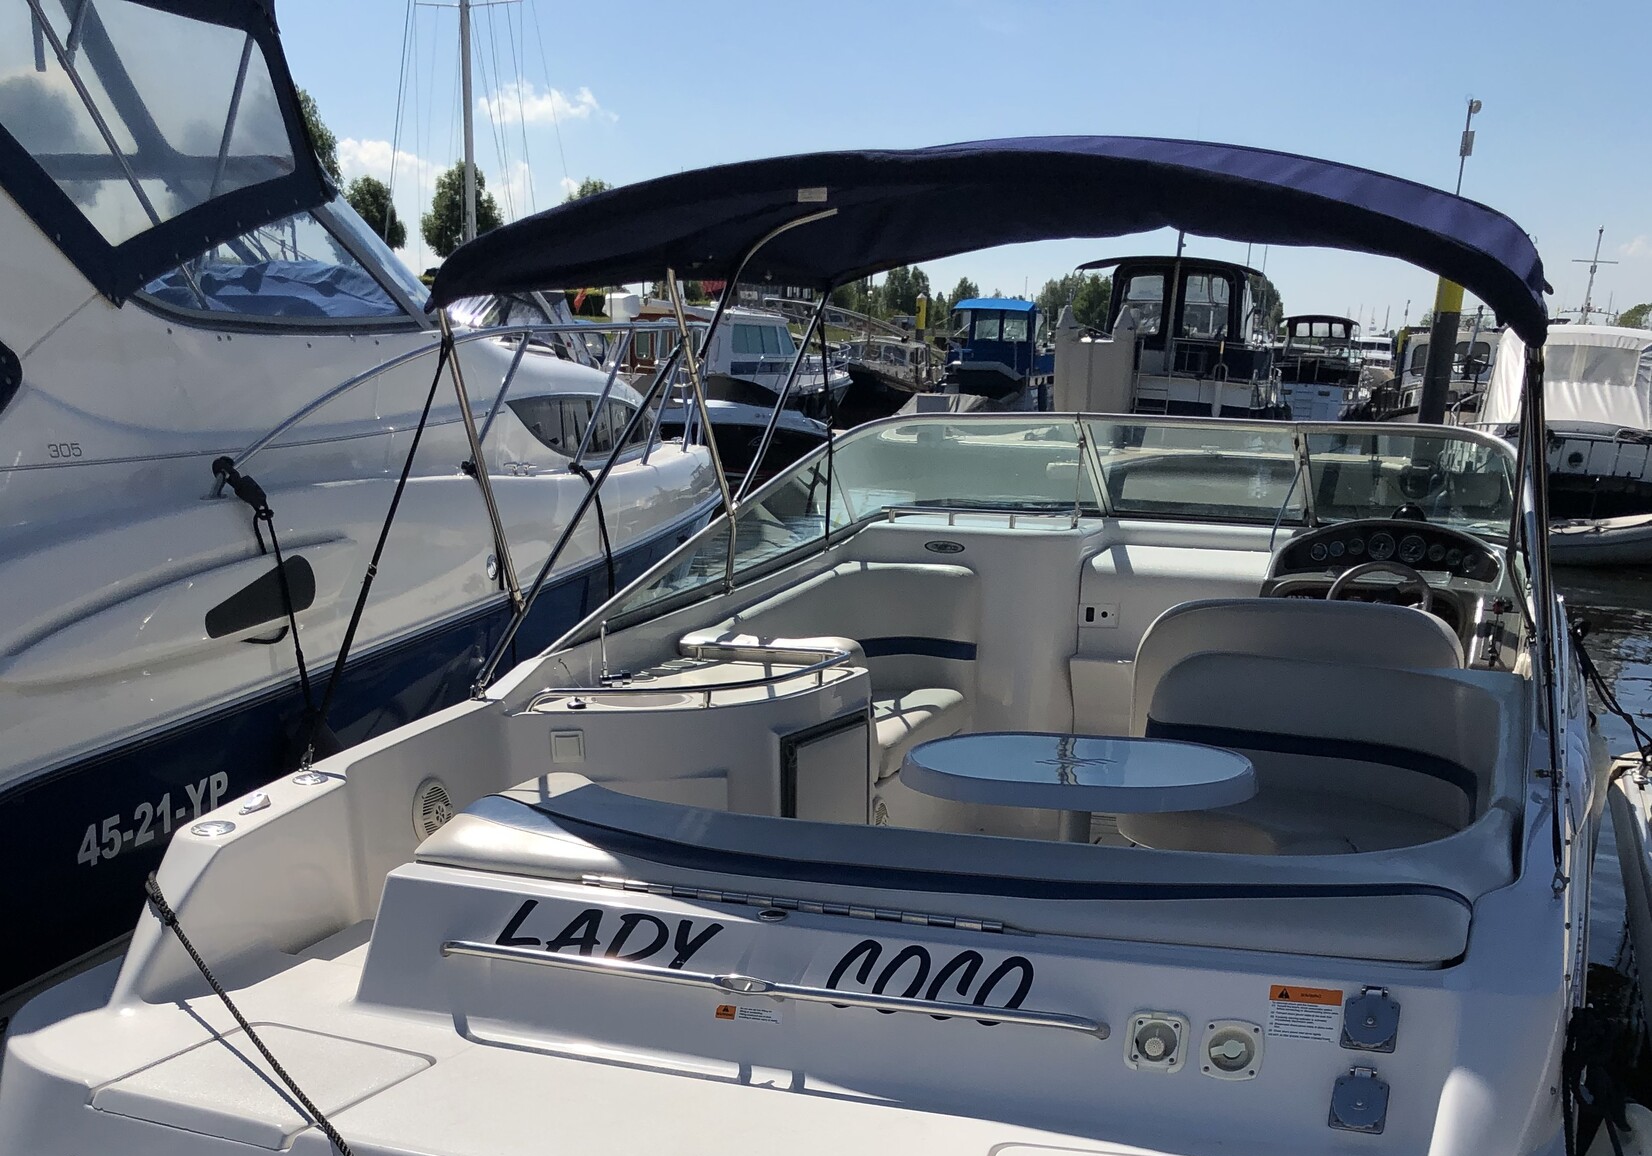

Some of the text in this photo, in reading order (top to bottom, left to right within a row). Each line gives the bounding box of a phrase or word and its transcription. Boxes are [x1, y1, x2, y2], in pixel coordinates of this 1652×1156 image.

[48, 443, 82, 458] 305
[77, 771, 228, 867] 45-21-YP
[495, 900, 1034, 1027] LADY COCO
